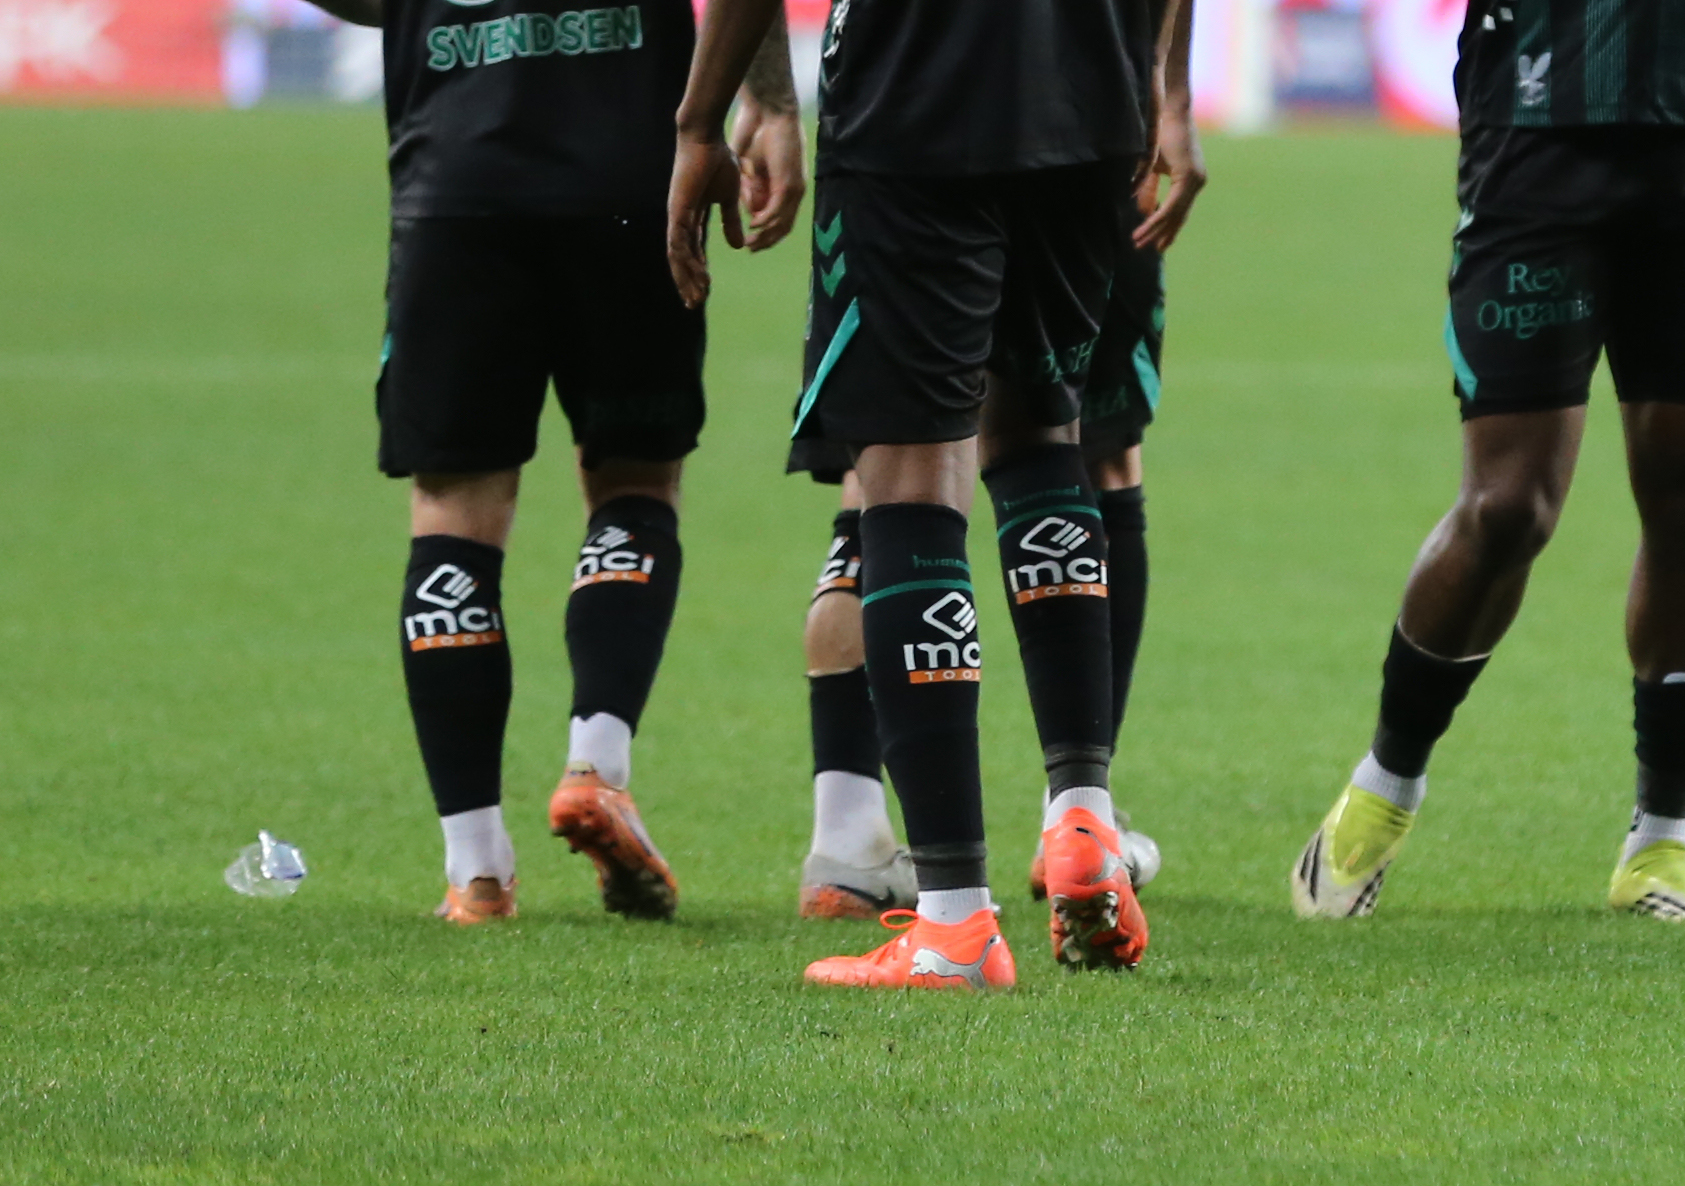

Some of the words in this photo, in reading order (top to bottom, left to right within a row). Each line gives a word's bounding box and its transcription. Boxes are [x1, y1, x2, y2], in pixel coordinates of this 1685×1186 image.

[427, 5, 643, 72] SVENDSEN
[1008, 557, 1108, 593] mci
[1028, 585, 1099, 600] TOOL
[404, 606, 501, 642] mci
